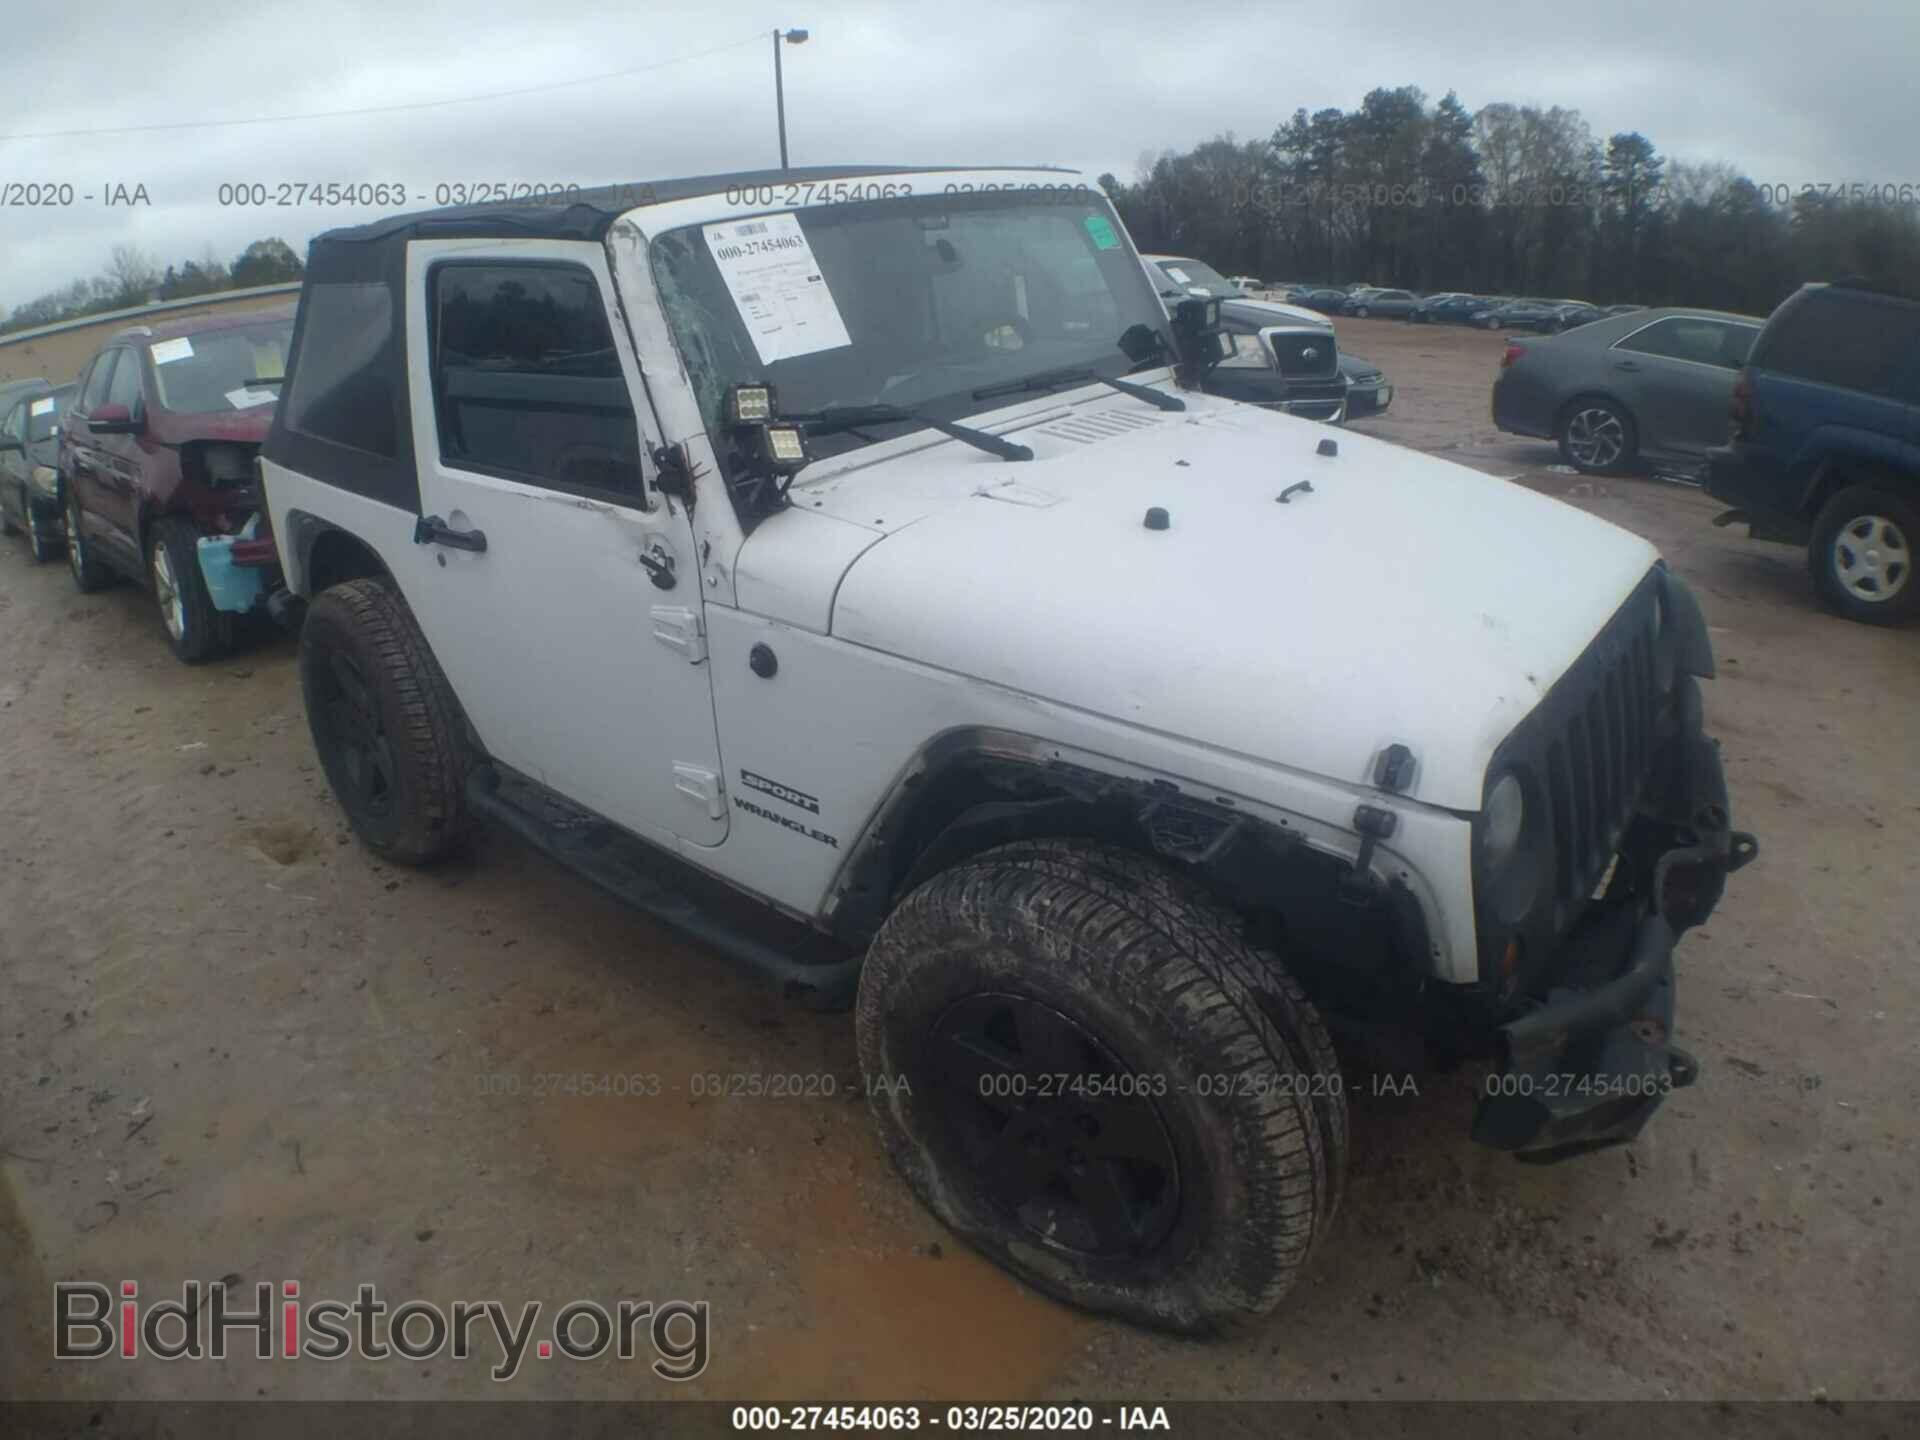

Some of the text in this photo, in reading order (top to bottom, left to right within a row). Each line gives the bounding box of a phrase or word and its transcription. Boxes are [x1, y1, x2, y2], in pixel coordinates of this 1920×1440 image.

[717, 235, 804, 260] 000-27454063
[740, 768, 820, 816] SPORT
[734, 796, 839, 849] WRANGLER
